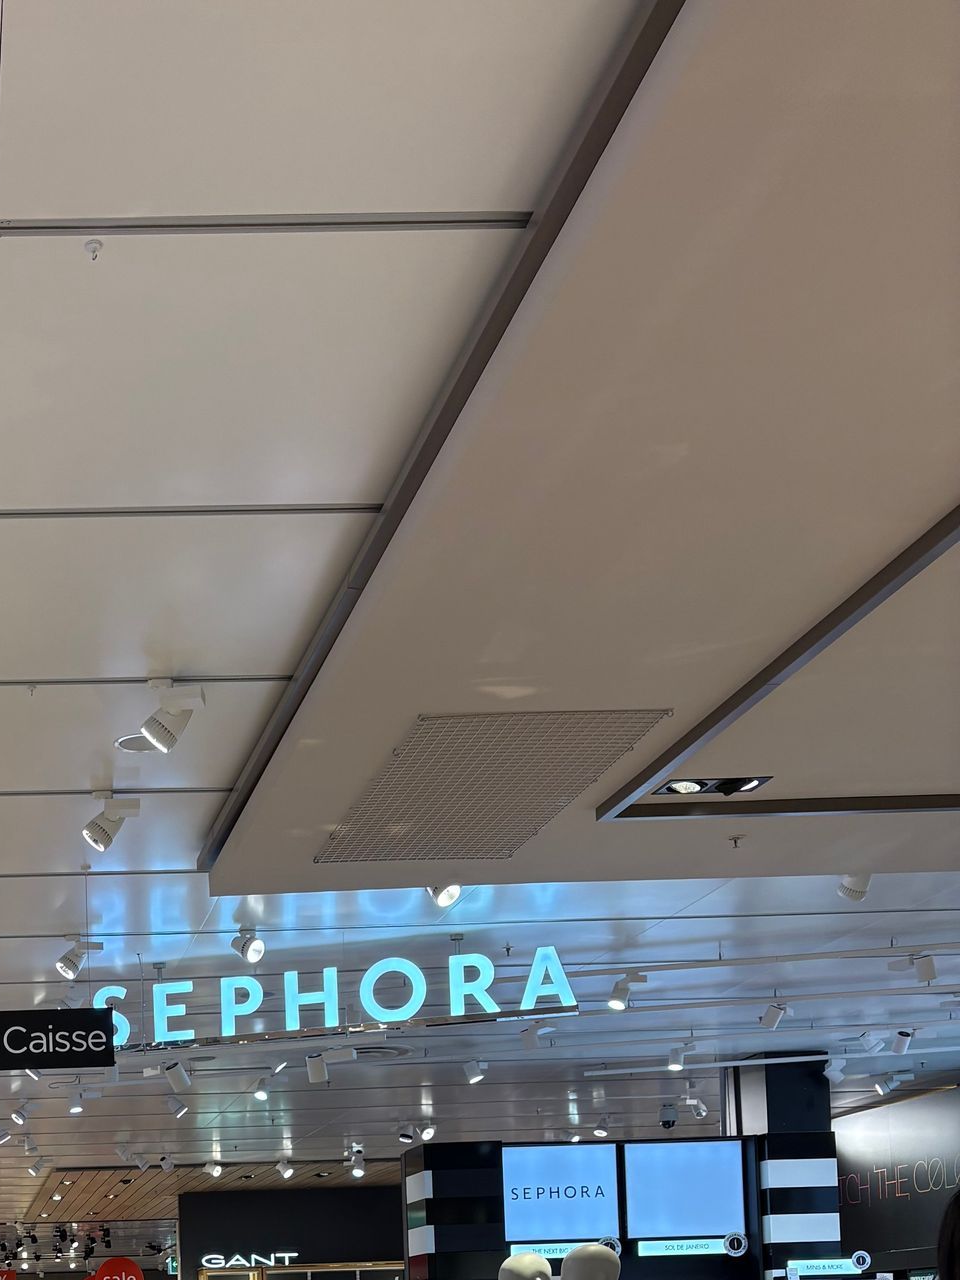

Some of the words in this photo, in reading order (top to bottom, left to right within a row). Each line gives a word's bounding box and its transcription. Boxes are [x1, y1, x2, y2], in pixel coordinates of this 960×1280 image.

[93, 946, 578, 1047] SEPHORA
[2, 1027, 107, 1056] Caisse
[511, 1185, 606, 1200] SEPHORA
[874, 1165, 910, 1201] THE
[201, 1252, 299, 1268] GANT
